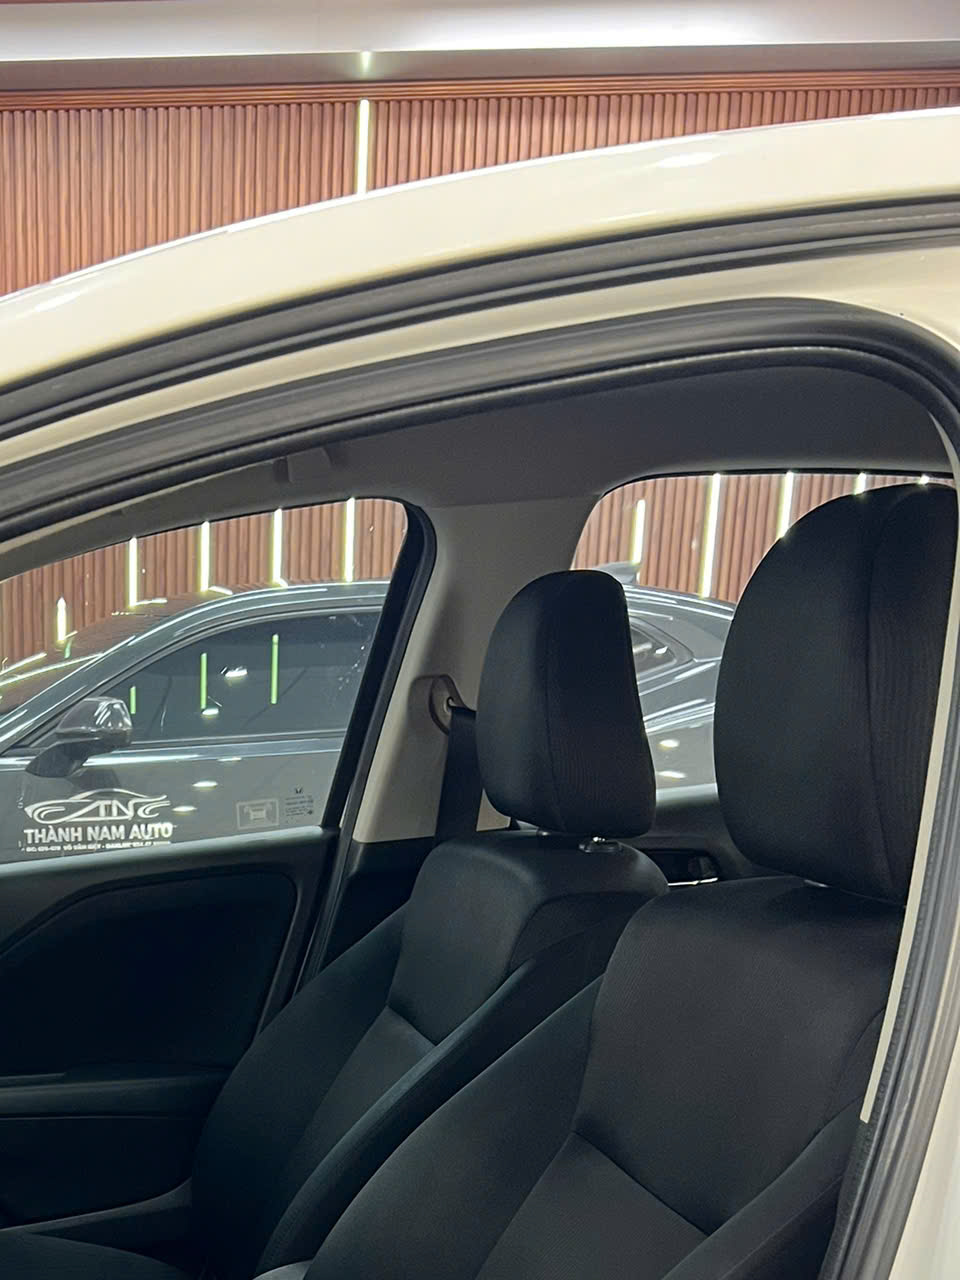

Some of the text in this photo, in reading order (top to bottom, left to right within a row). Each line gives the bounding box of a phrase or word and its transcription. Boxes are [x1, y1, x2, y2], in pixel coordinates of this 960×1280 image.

[24, 822, 173, 843] THÀNH NAM AUTO
